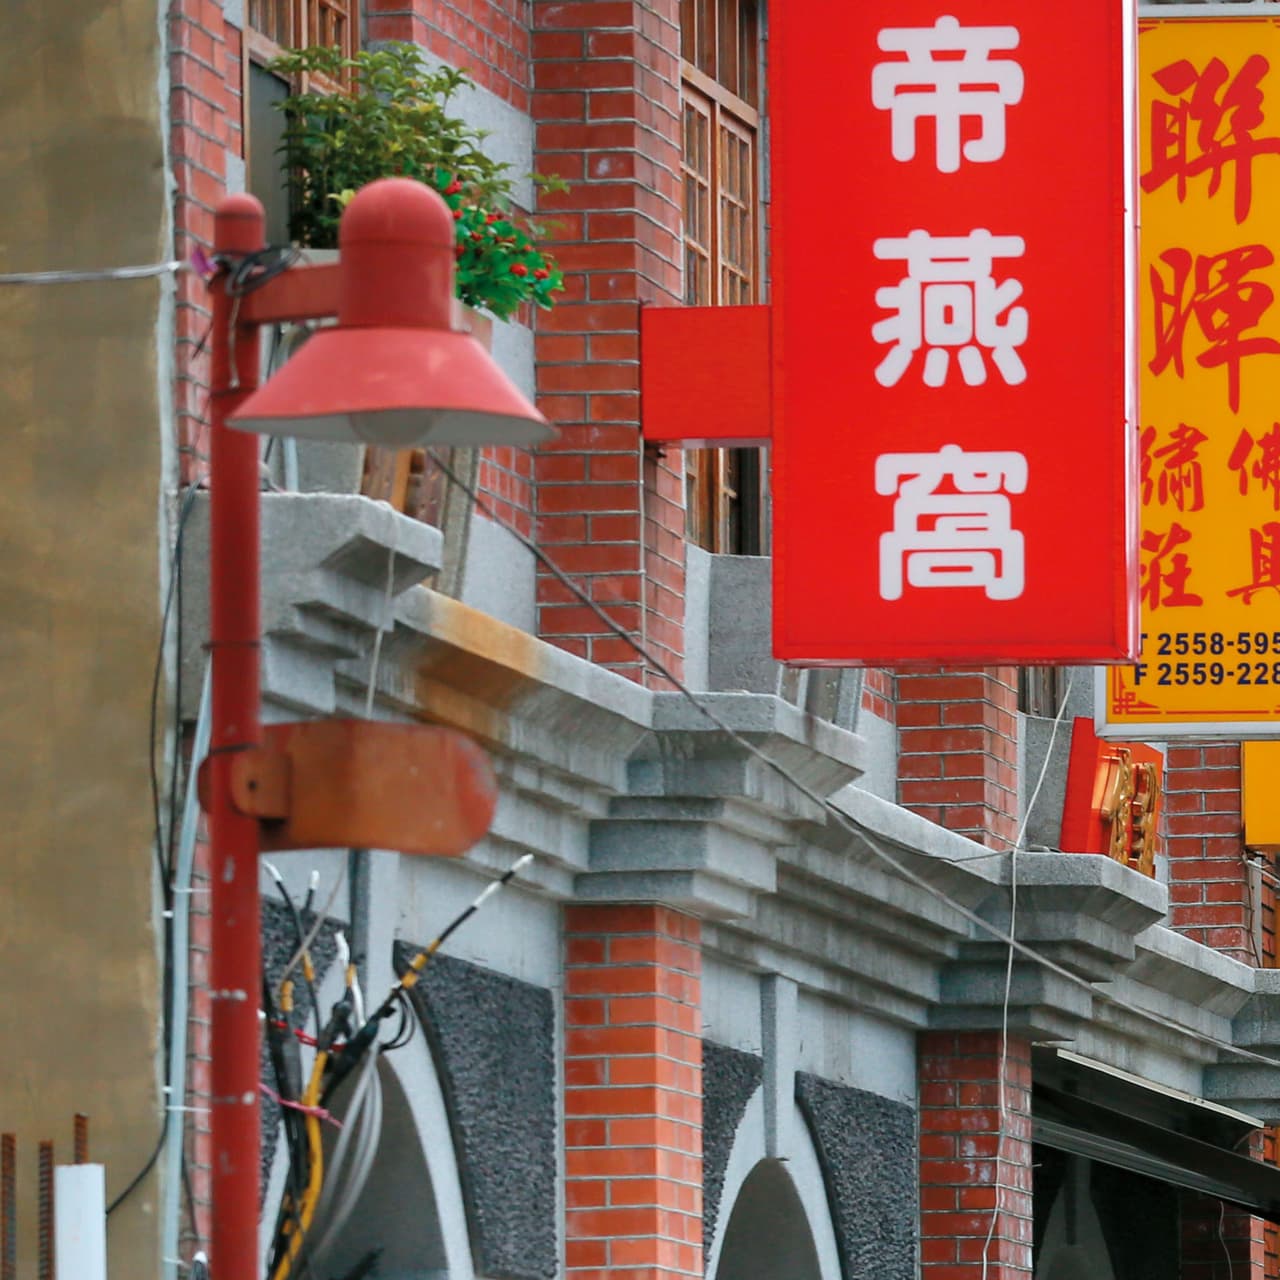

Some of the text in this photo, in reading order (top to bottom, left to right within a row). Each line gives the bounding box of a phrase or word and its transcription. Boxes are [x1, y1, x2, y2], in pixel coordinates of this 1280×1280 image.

[870, 15, 1029, 601] 帝燕窩
[1134, 663, 1148, 687] F
